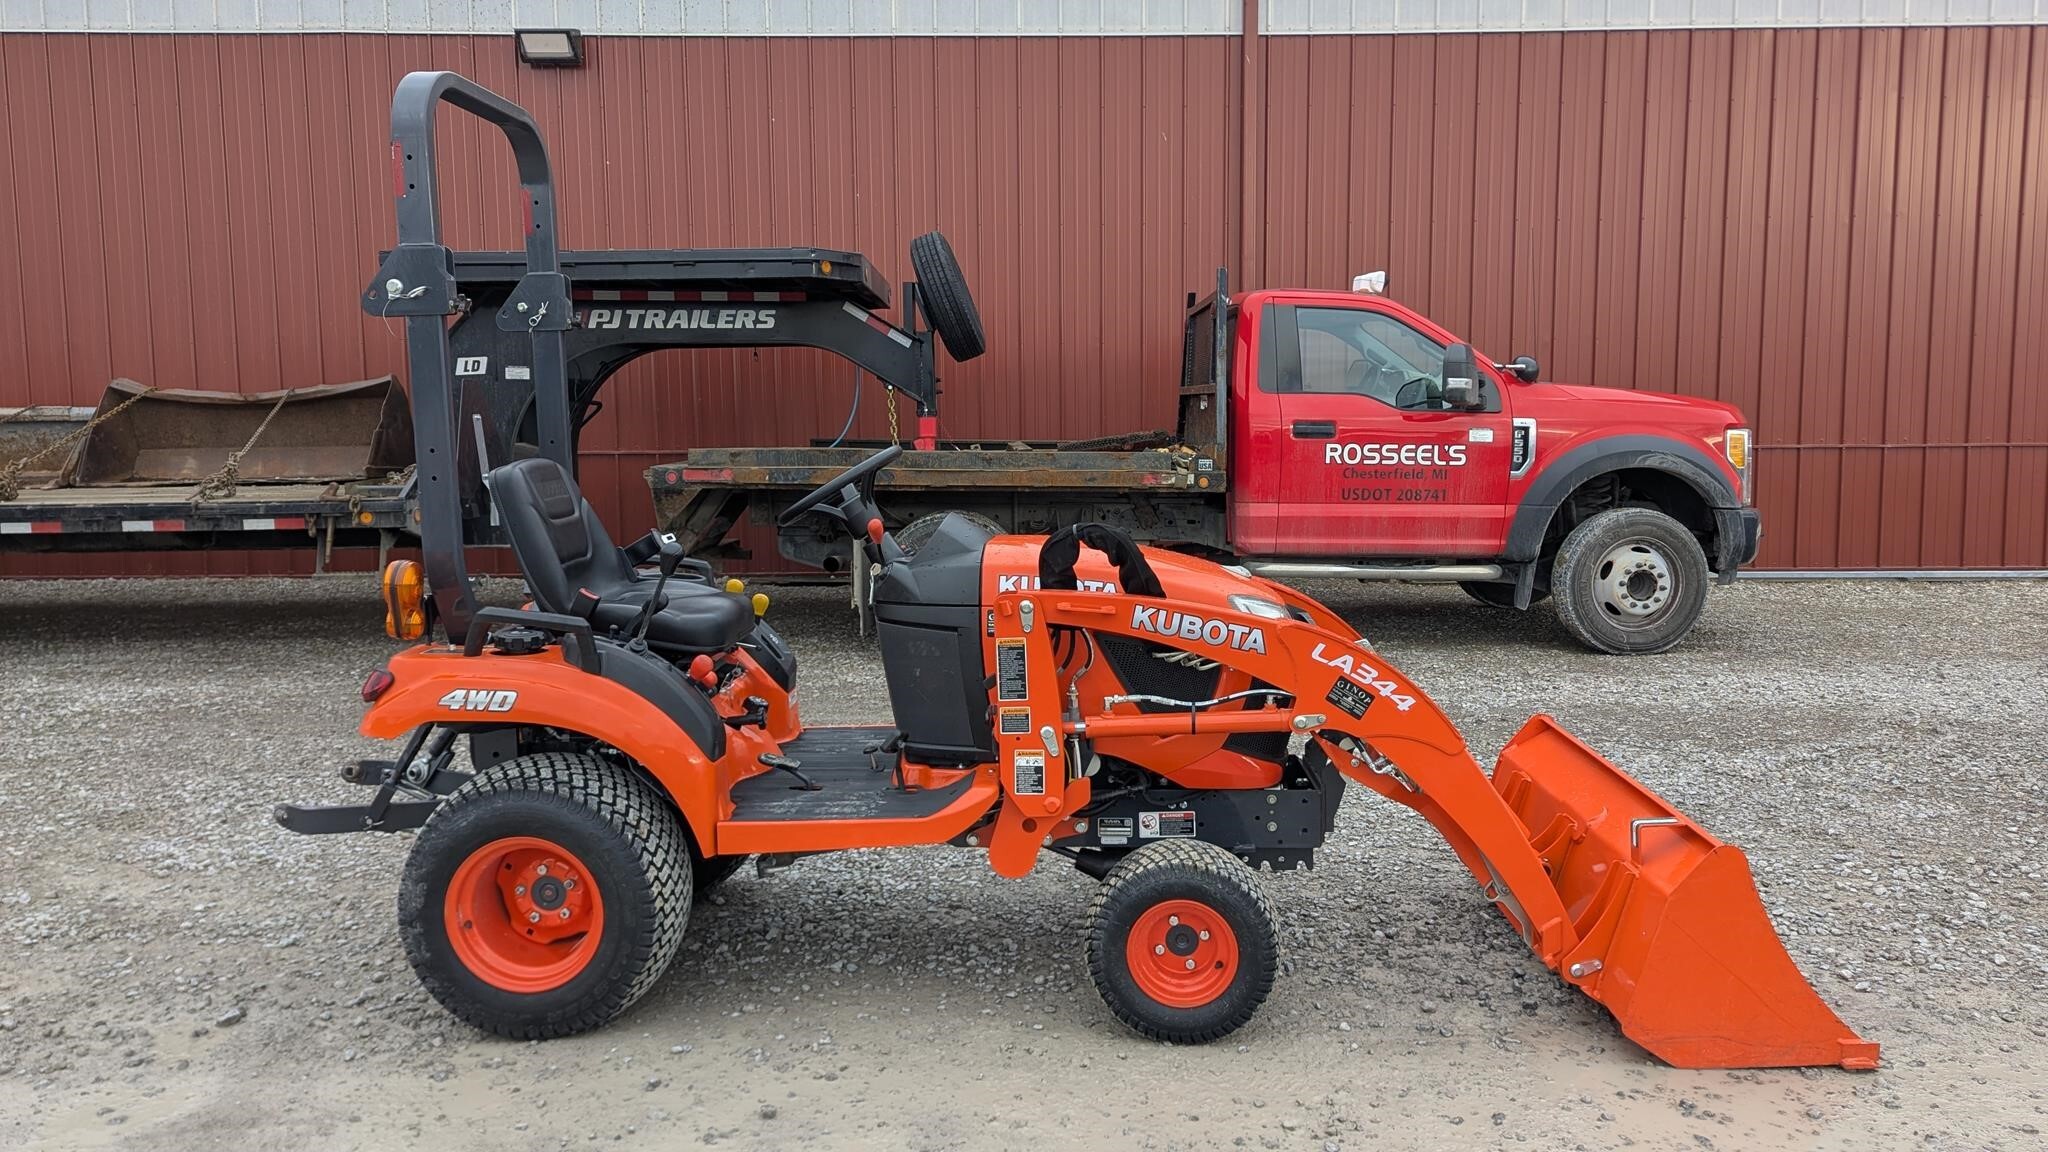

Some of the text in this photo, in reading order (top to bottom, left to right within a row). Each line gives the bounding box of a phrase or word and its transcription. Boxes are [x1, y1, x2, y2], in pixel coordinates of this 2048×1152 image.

[588, 309, 776, 329] PJ TRAILERS
[463, 360, 481, 373] LD
[1324, 443, 1467, 466] ROSSEEL'S
[1343, 467, 1448, 482] Chesterfield, MI
[1341, 488, 1447, 501] USDOT 208741
[1130, 603, 1267, 655] KUBOTA
[1311, 643, 1416, 711] LA344
[438, 688, 518, 712] 4WD
[1337, 680, 1371, 703] GINOP
